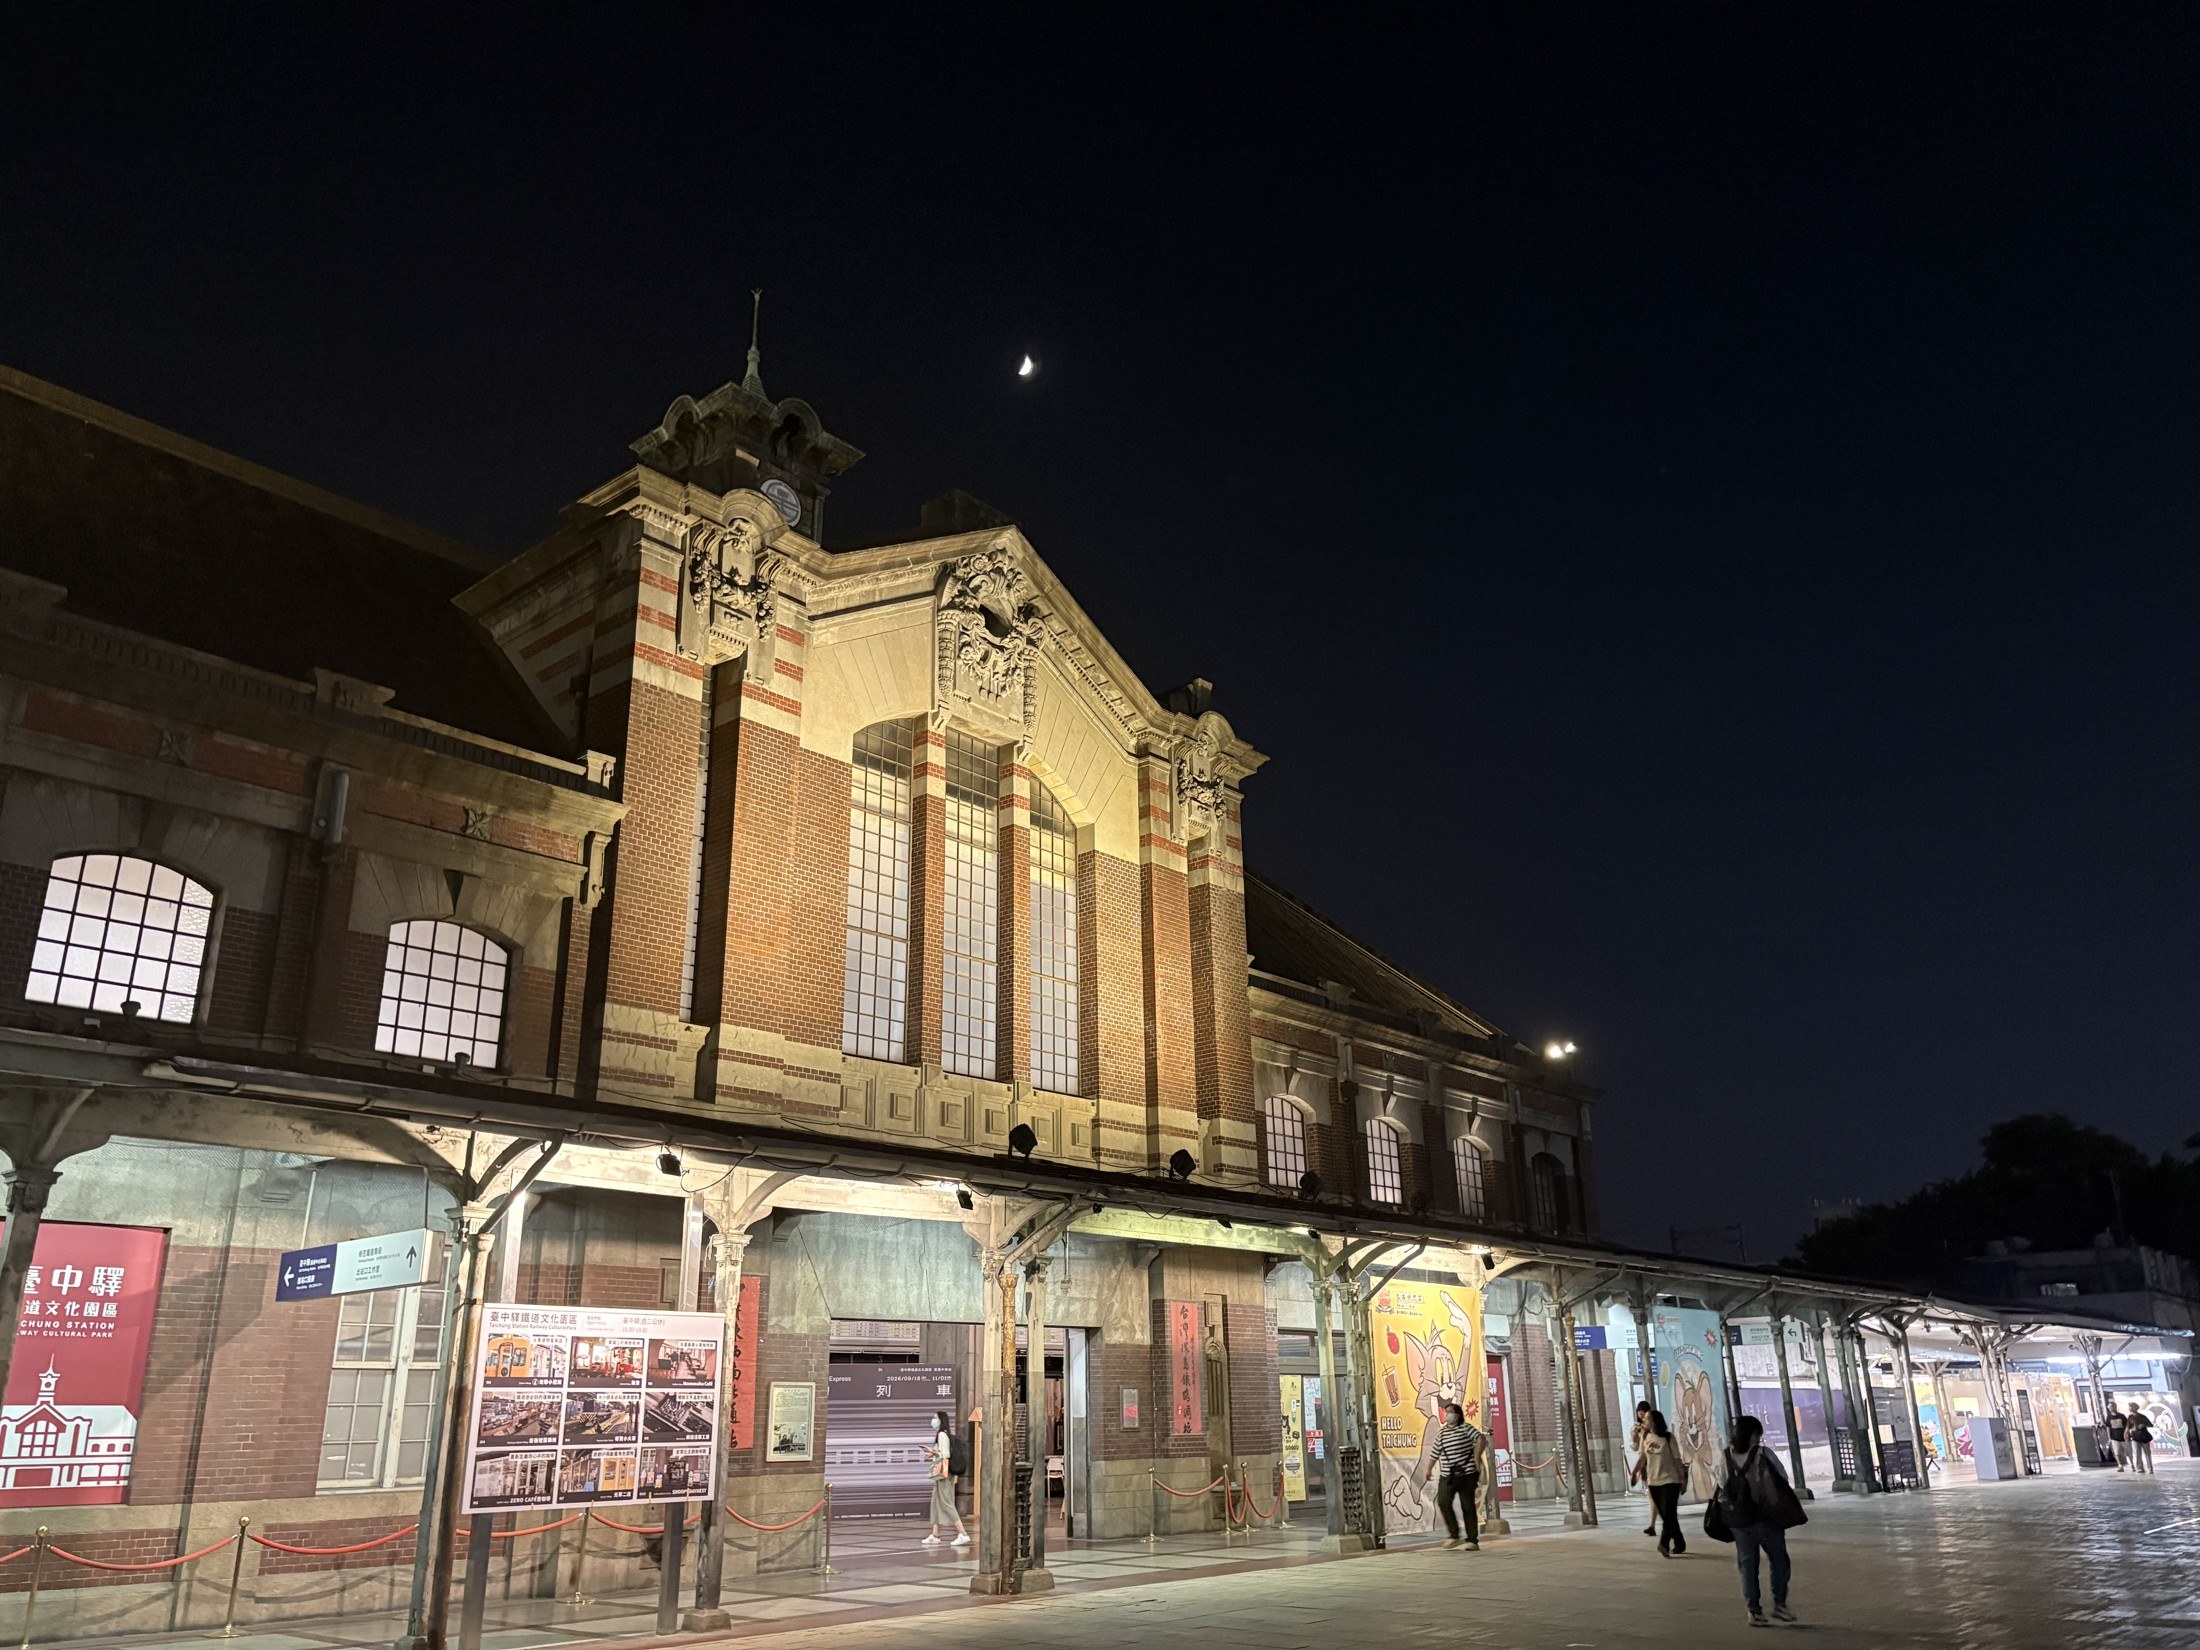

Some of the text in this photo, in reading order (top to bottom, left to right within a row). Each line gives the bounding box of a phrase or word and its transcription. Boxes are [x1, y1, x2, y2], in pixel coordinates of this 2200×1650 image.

[66, 1321, 115, 1329] STATION
[829, 1375, 851, 1383] Express
[936, 1384, 952, 1397] 車
[1381, 1416, 1403, 1431] HELLO
[1381, 1433, 1417, 1449] TAICHUNG
